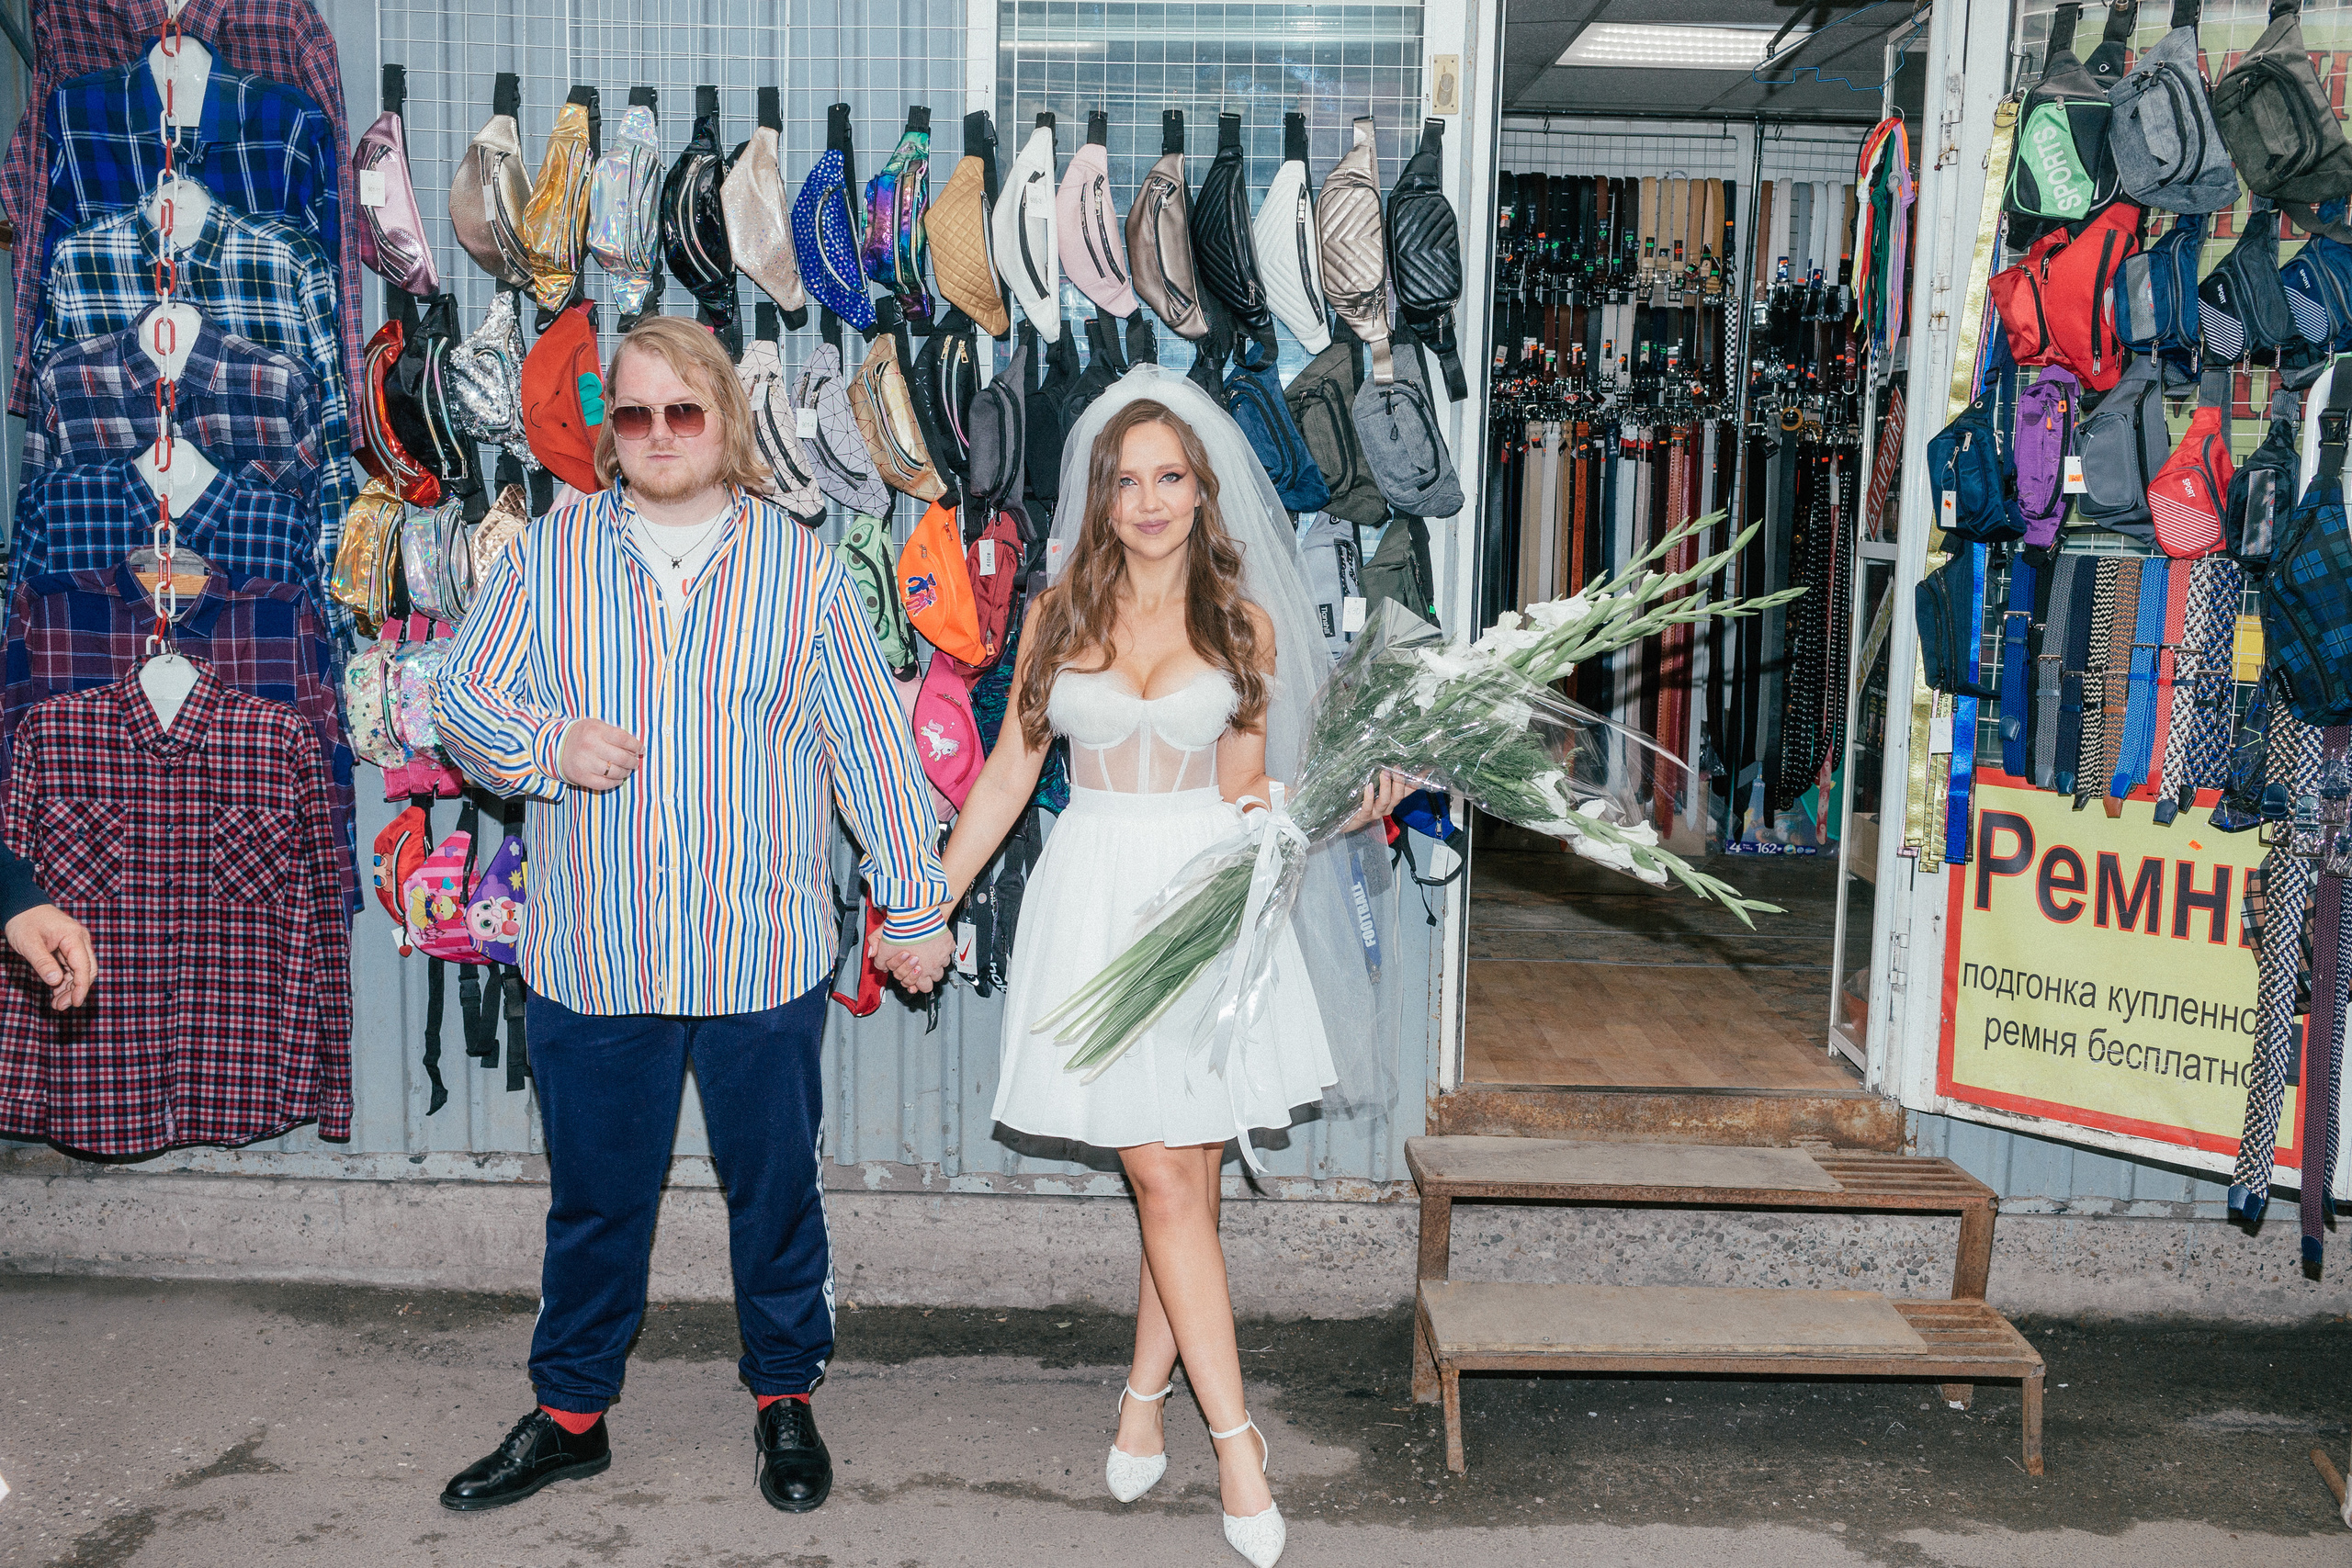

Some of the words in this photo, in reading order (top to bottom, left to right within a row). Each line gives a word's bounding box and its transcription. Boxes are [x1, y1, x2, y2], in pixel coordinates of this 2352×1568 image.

[2034, 126, 2082, 211] SPORTS
[2217, 283, 2226, 304] SPORT
[2300, 268, 2311, 289] SPORT
[2181, 478, 2196, 499] SPORT
[1729, 842, 1742, 853] 4
[1756, 842, 1777, 853] 162
[1351, 881, 1376, 948] FOOTBALL
[1962, 962, 2097, 1009] подгонка
[2108, 985, 2257, 1035] купленно
[1984, 1016, 2076, 1058] ремня
